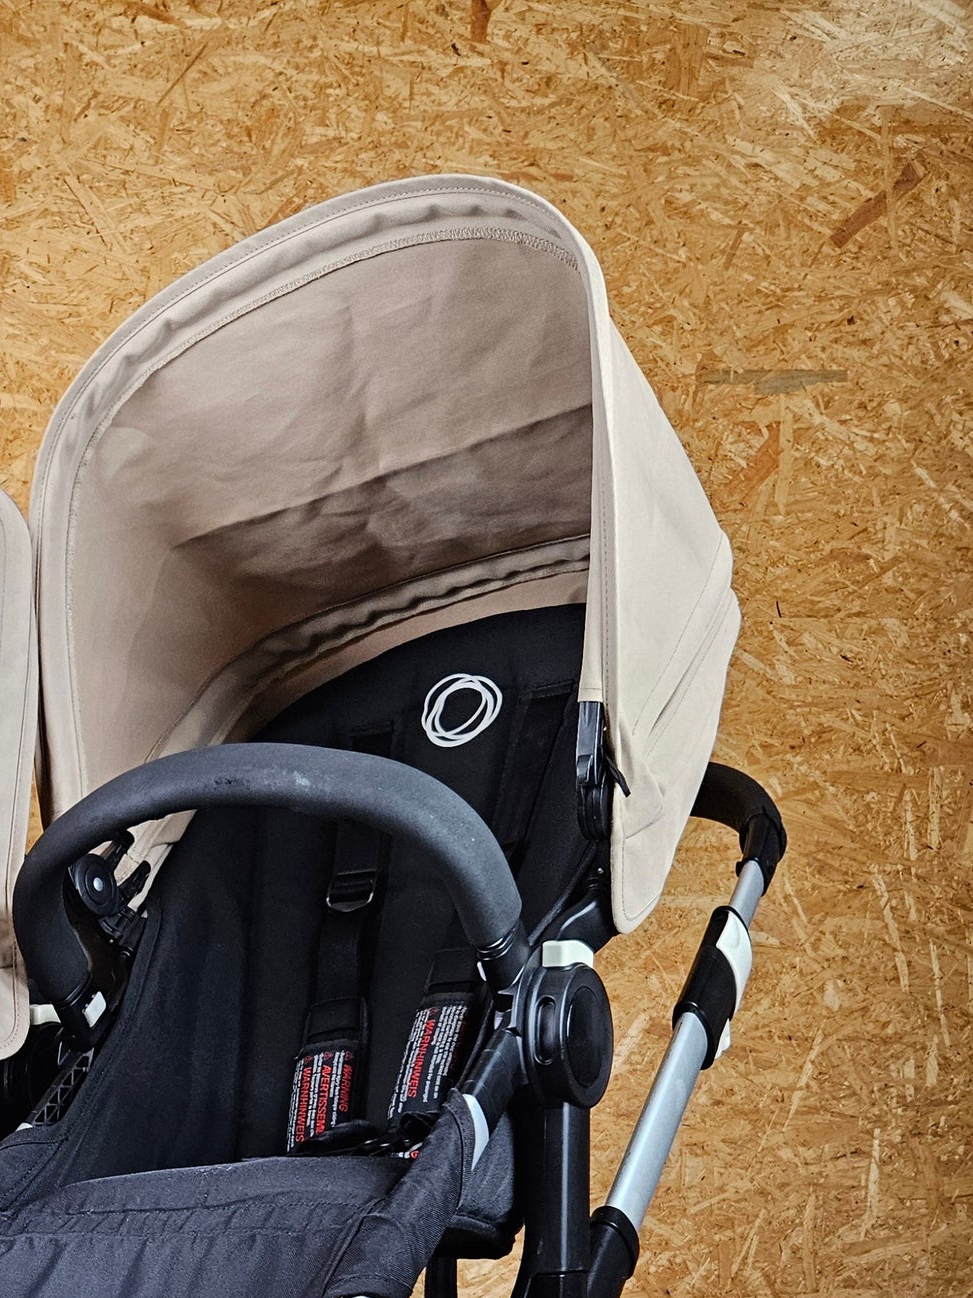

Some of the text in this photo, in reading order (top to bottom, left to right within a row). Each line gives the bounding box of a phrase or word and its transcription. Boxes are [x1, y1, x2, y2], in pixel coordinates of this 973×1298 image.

[338, 1064, 353, 1112] WARNING
[408, 1020, 436, 1098] WARNHINWEIS
[295, 1067, 312, 1142] WARNHINWEIS
